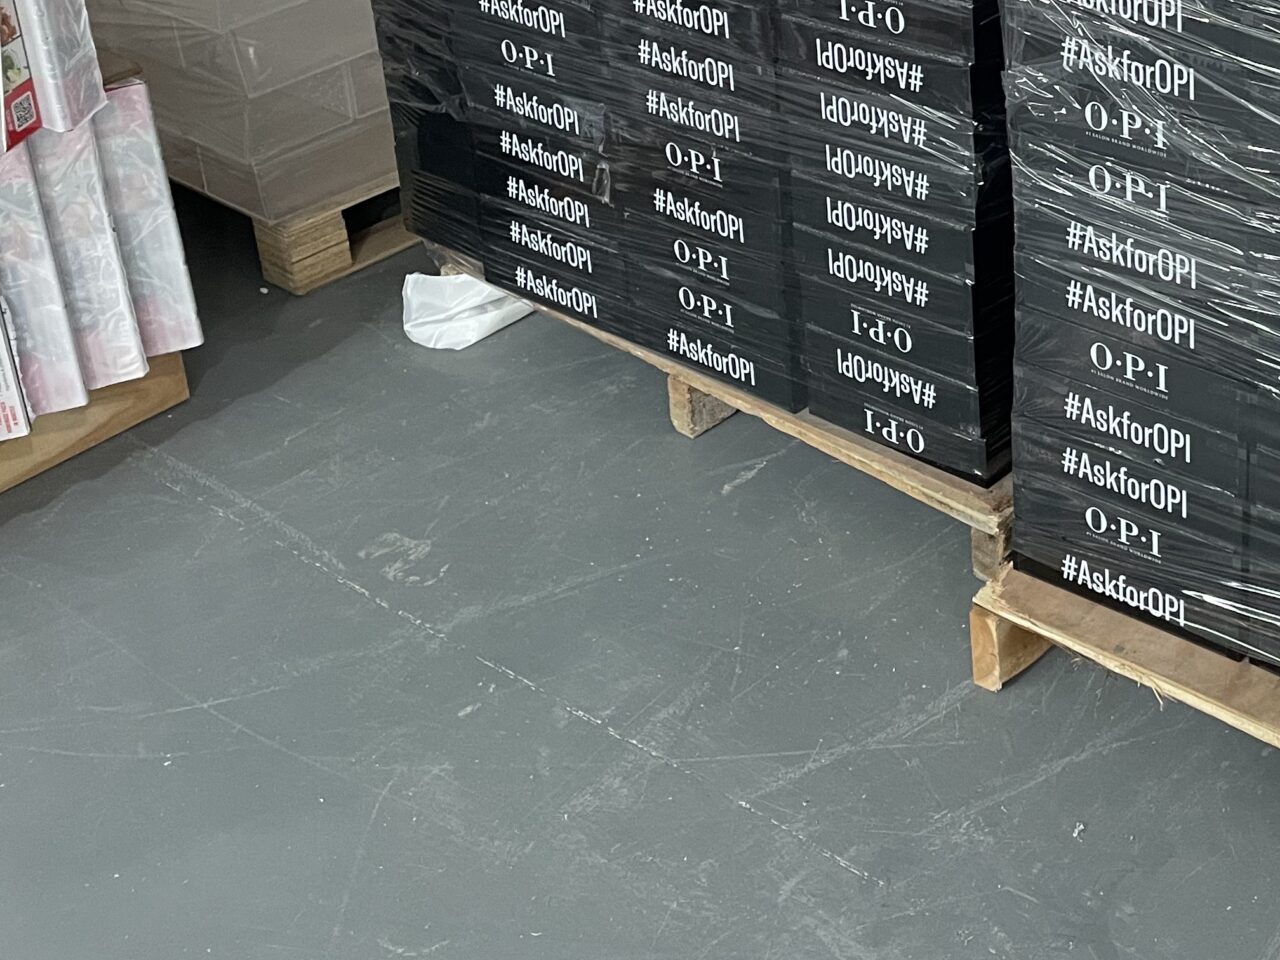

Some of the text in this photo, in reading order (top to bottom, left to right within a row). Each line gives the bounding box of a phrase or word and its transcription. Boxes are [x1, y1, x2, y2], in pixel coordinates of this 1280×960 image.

[501, 39, 555, 76] O·P·I
[638, 39, 734, 91] #AskforOPI
[815, 38, 923, 93] #AskforOPI
[1061, 35, 1195, 101] #AskforOPI
[494, 84, 580, 135] #AskforOPI
[646, 89, 740, 142] #AskforOPI
[820, 92, 928, 148] #AskforOPI
[1084, 101, 1168, 150] O·P·I
[499, 131, 584, 182] #AskforOPI
[665, 142, 723, 182] O·P·I
[825, 144, 929, 200] #AskforOPI
[506, 176, 590, 227] #AskforOPI
[1088, 164, 1170, 214] O·P·I
[653, 188, 744, 243] #AskforOPI
[826, 196, 929, 254] #AskforOPI
[509, 221, 592, 273] #AskforOPI
[673, 239, 729, 280] O·P·I
[1066, 221, 1196, 289] #AskforOPI
[515, 266, 598, 318] #AskforOPI
[828, 248, 929, 307] #AskforOPI
[678, 287, 734, 327] O·P·I
[851, 309, 912, 353] O·P·I
[1066, 280, 1195, 349] #AskforOPI
[667, 329, 755, 386] #AskforOPI
[837, 348, 936, 409] #AskforOPI
[1090, 342, 1169, 394] O·P·I
[864, 408, 925, 454] O·P·I
[1064, 392, 1191, 463] #AskforOPI
[1061, 447, 1187, 518] #AskforOPI
[1085, 506, 1162, 558] O·P·I
[1061, 554, 1185, 627] #AskforOPI
